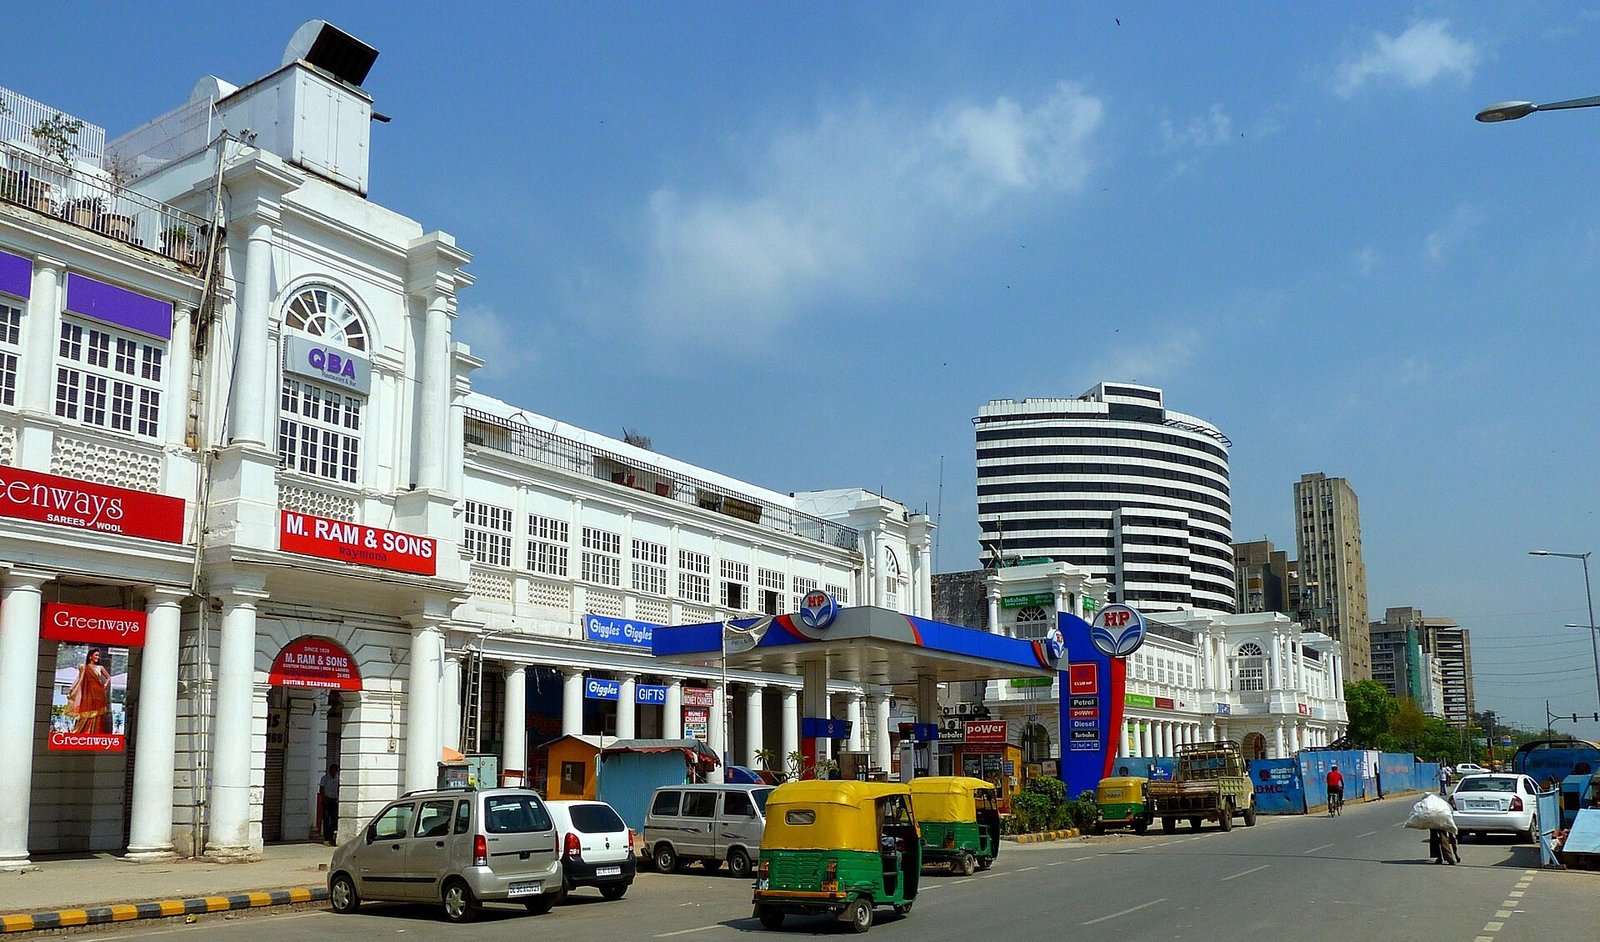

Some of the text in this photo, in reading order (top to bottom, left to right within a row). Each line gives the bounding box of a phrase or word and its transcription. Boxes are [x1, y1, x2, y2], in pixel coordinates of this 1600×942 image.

[308, 348, 355, 380] QBA
[46, 513, 123, 533] SAREES WOOL
[286, 514, 432, 558] M. RAM & SONS
[339, 546, 387, 562] Raymond
[808, 595, 825, 608] HP
[54, 611, 140, 636] Greenways
[1104, 611, 1130, 626] HP
[590, 618, 652, 642] Giggles Giggles
[285, 652, 348, 668] M. RAM & SONS
[306, 680, 340, 688] READYMADES
[589, 681, 618, 696] Giggles
[639, 688, 665, 700] GIFTS
[52, 732, 120, 750] Greenways
